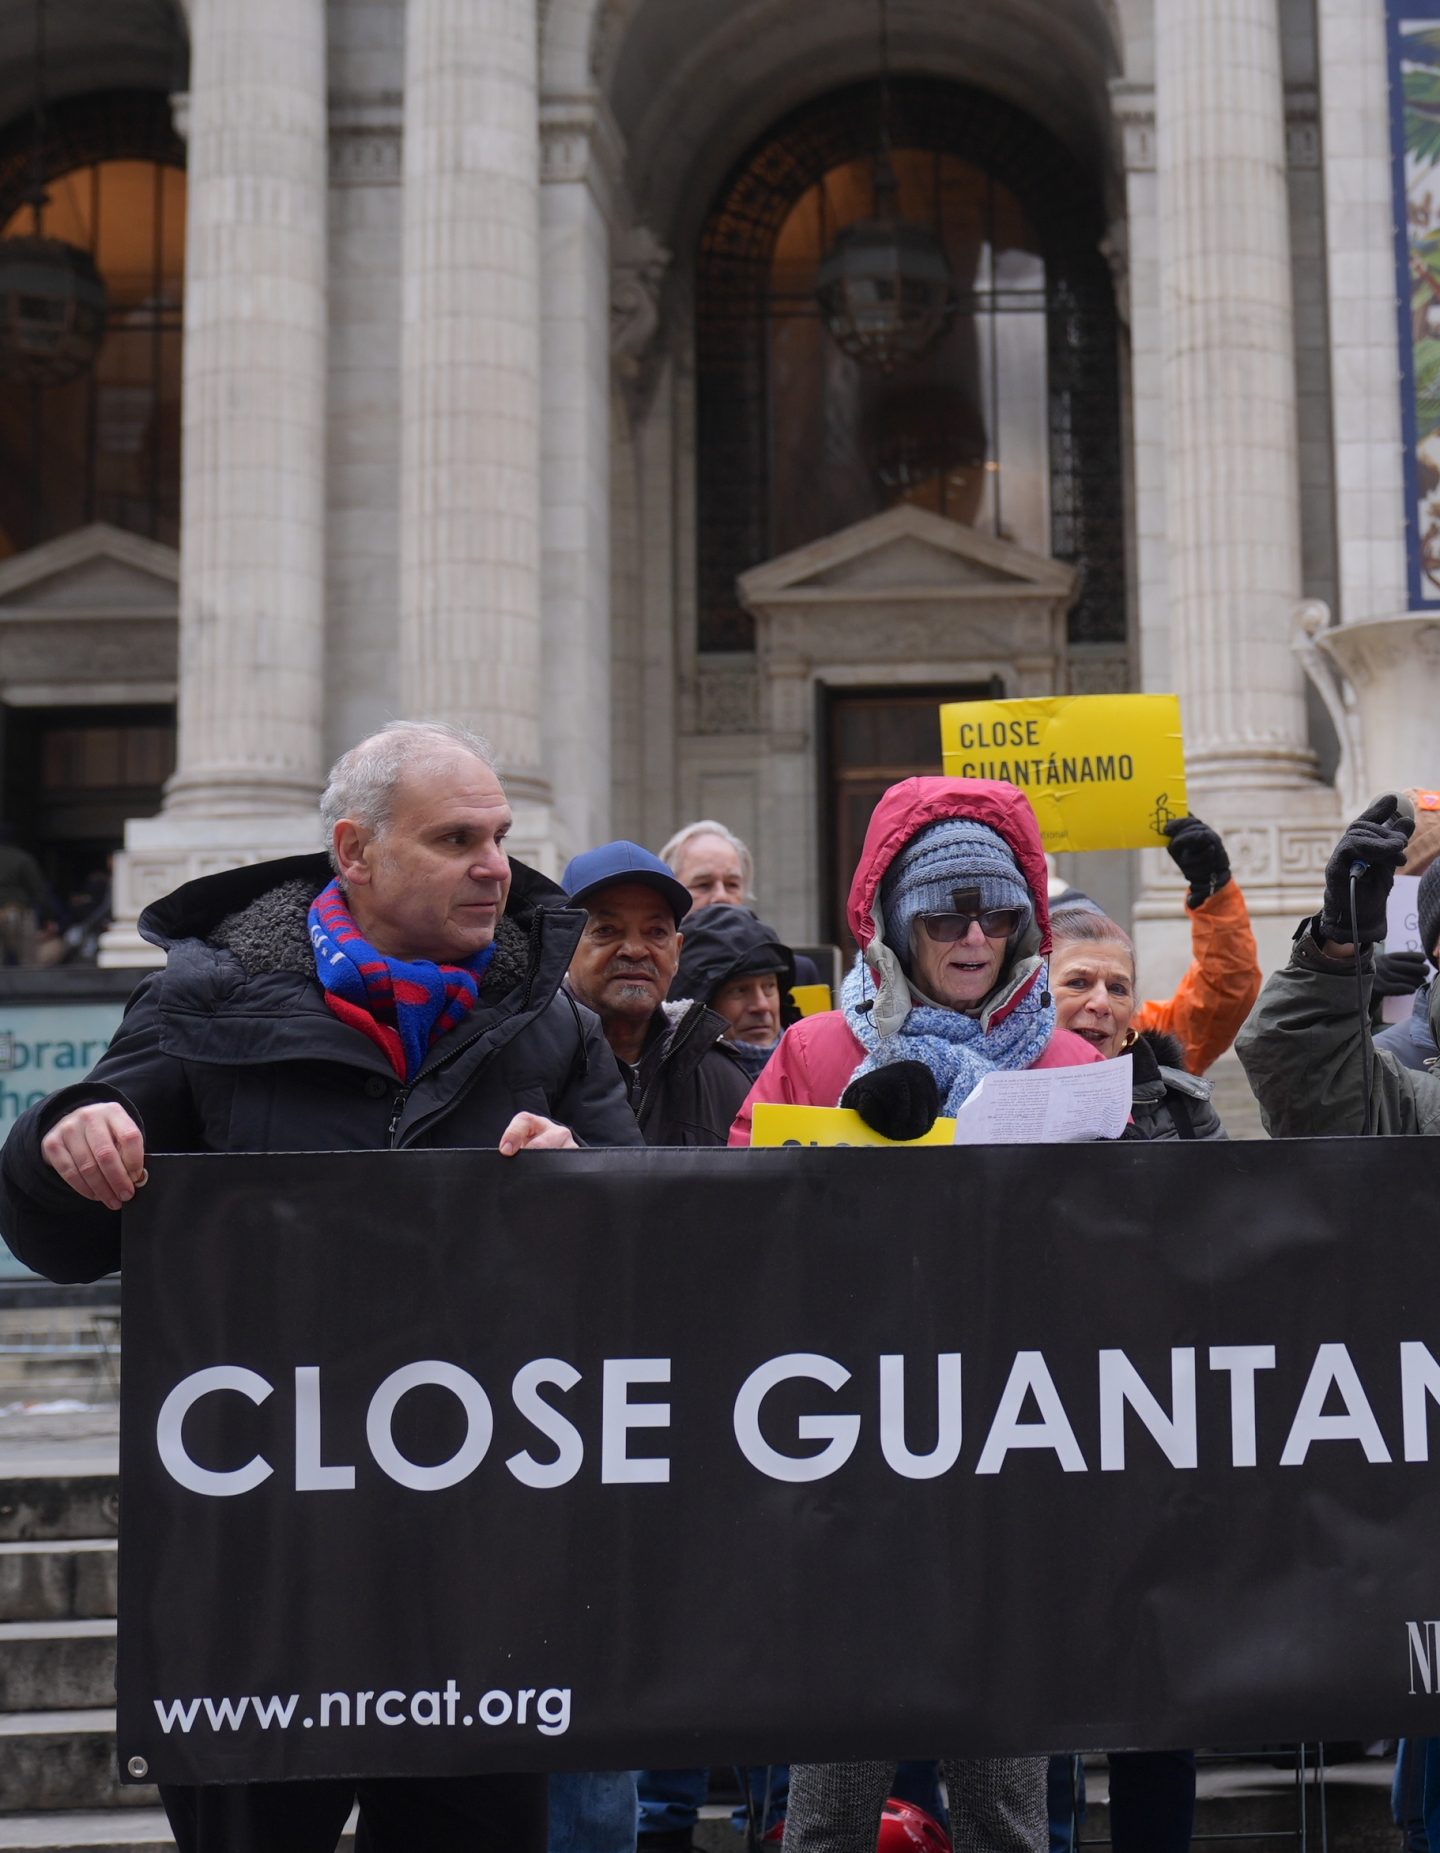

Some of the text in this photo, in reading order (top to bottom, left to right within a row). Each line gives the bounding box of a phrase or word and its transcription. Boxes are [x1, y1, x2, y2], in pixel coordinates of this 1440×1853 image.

[960, 721, 1040, 749] CLOSE
[156, 1357, 671, 1497] CLOSE
[153, 1680, 572, 1736] www.nrcat.org
